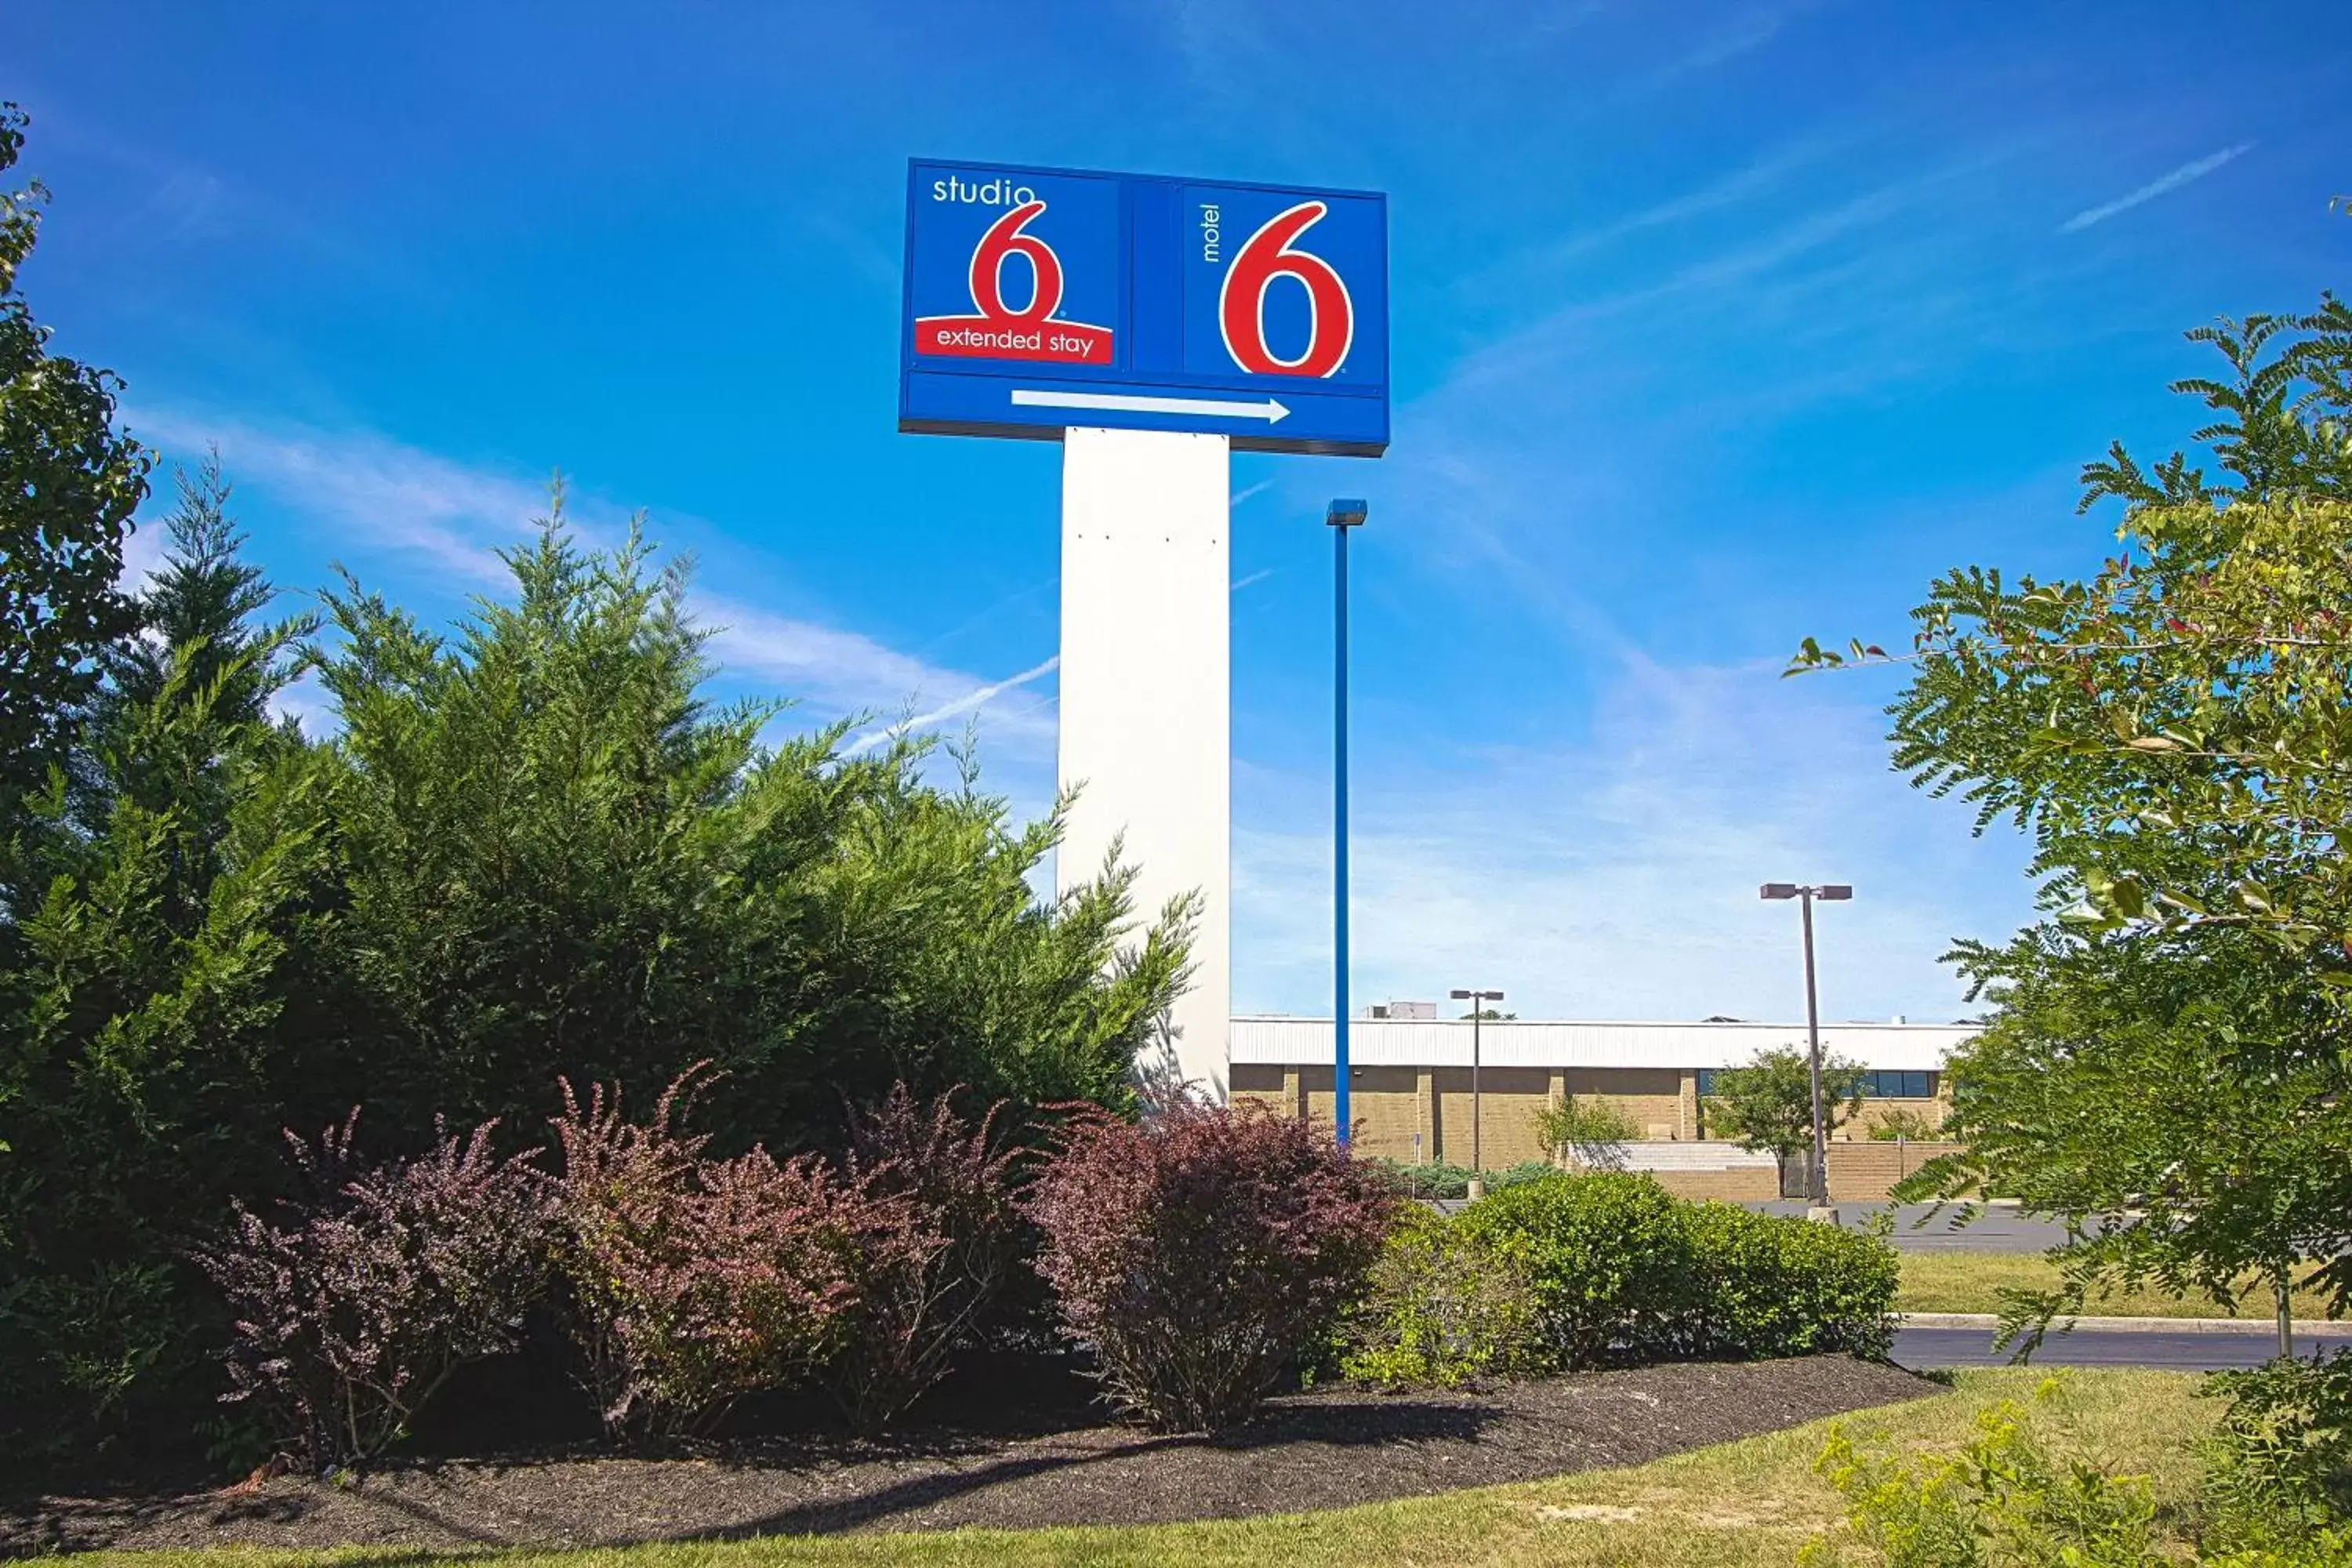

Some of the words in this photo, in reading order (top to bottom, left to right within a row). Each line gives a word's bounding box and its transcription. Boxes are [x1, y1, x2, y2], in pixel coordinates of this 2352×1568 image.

[933, 175, 1036, 205] studio
[969, 200, 1063, 321] 6
[1199, 205, 1219, 263] motel
[1219, 200, 1354, 379] 6
[937, 327, 1040, 350] extended
[1050, 332, 1094, 358] stay
